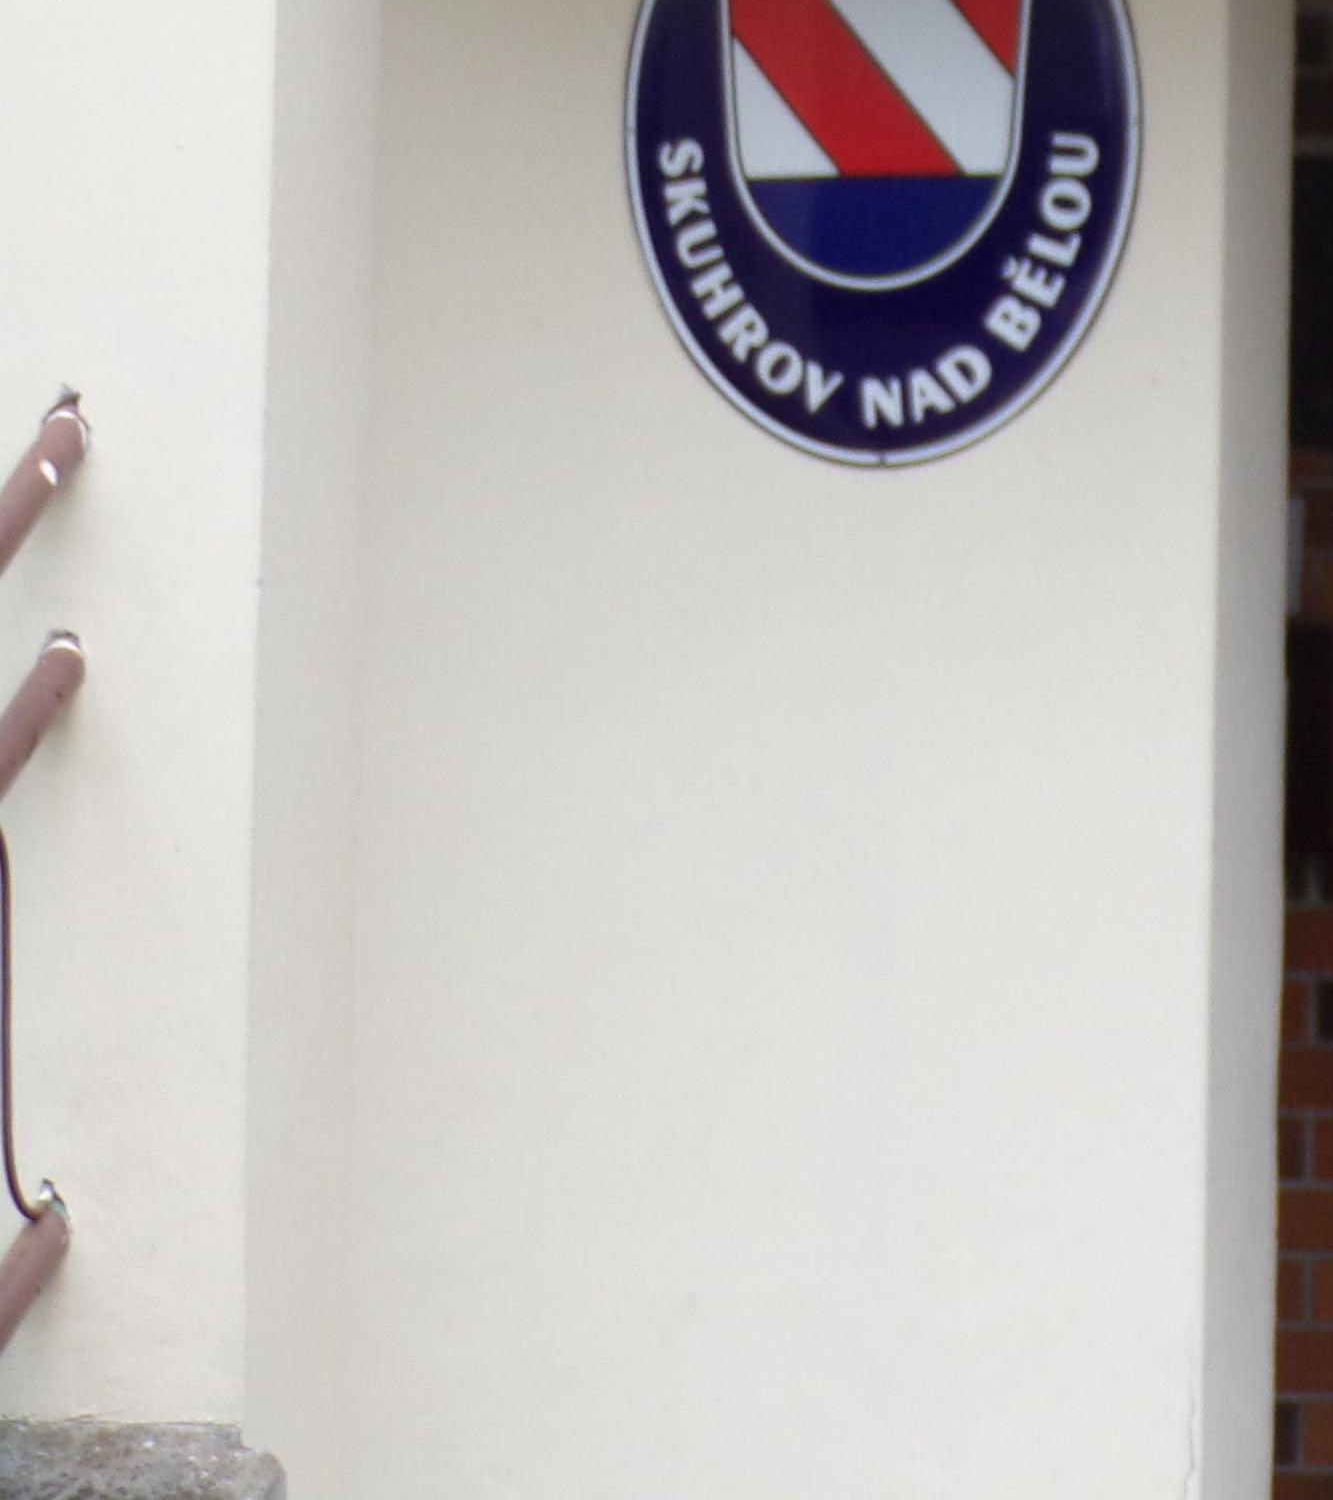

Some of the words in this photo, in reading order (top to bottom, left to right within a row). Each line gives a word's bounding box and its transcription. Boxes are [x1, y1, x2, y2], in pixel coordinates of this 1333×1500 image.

[658, 137, 844, 414] SKUHROV
[859, 344, 993, 429] NAD
[983, 131, 1100, 352] BĚLOU
